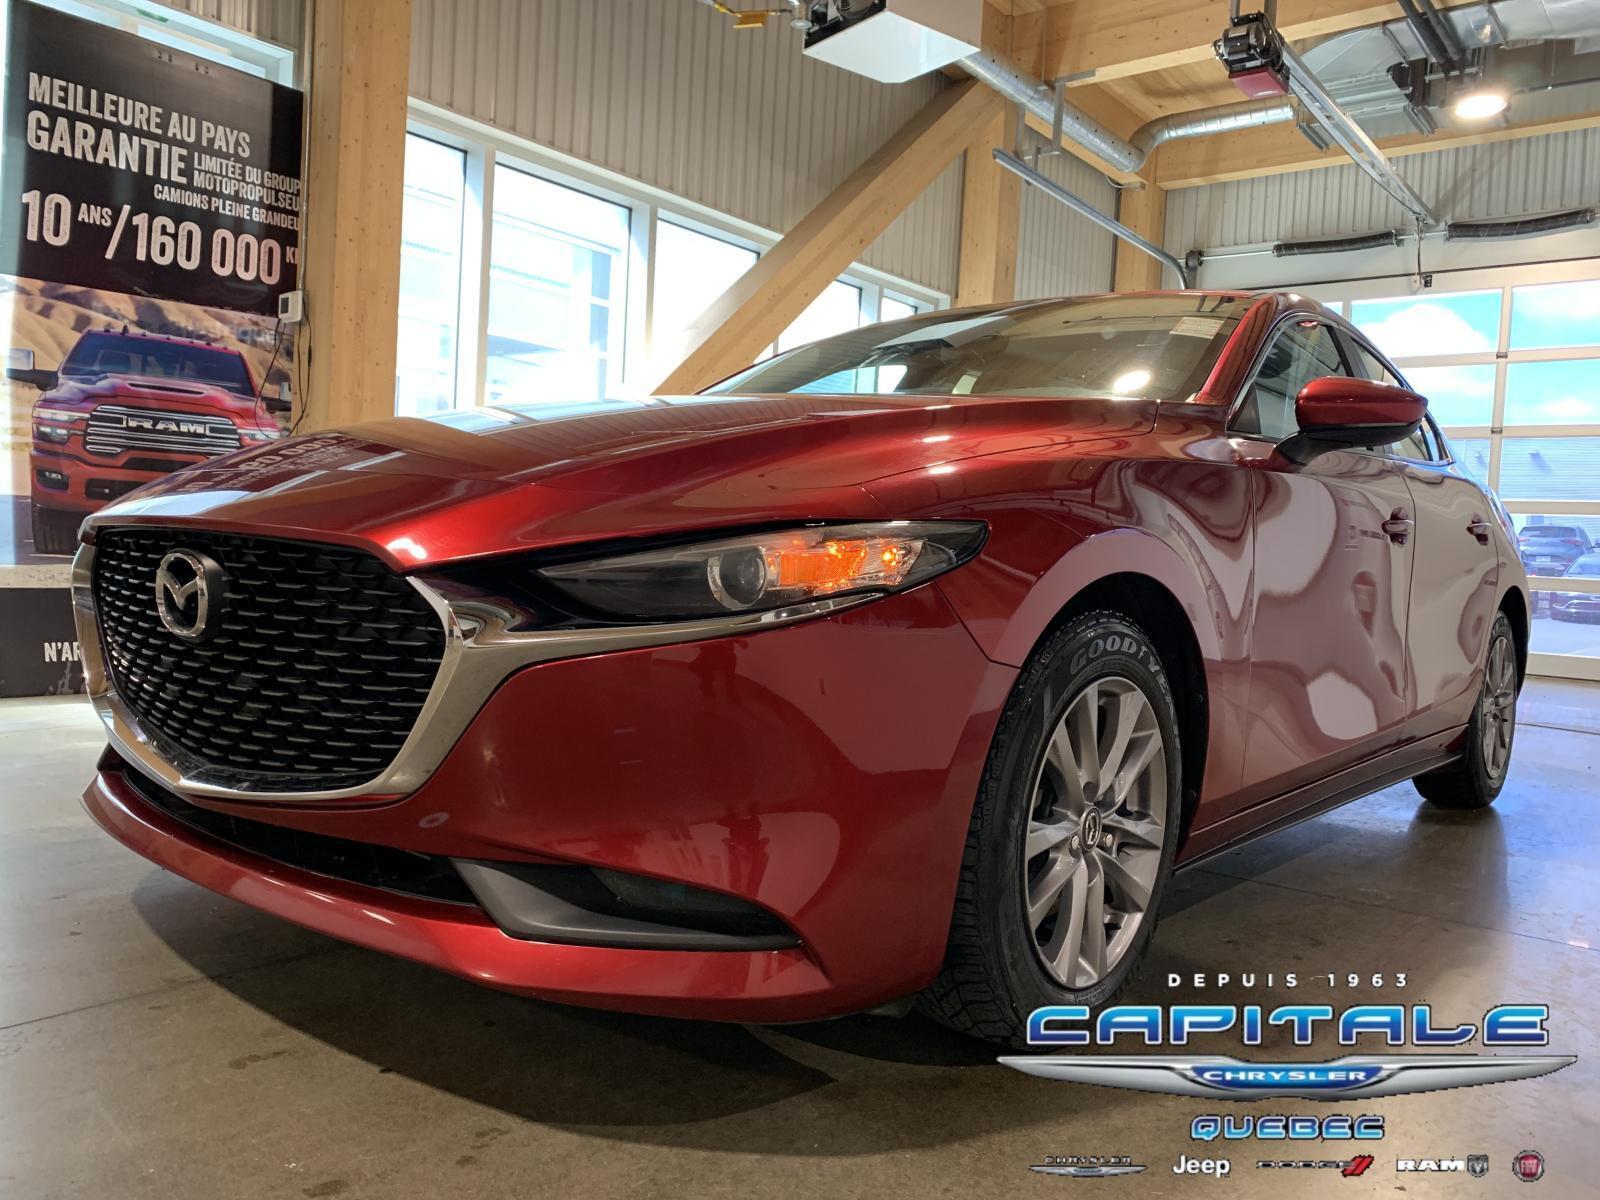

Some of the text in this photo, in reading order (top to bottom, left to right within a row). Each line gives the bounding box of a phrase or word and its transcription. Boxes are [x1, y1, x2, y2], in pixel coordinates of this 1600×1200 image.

[28, 71, 250, 158] MEILLEURE AU PAYS
[26, 109, 188, 185] GARANTIE
[193, 151, 243, 180] LIMITÉE
[245, 165, 261, 185] DU
[153, 184, 209, 210] CAMIONS
[211, 197, 251, 220] PLEINE
[21, 189, 72, 247] 10
[77, 202, 113, 227] ANS
[211, 228, 281, 285] 000
[127, 417, 205, 434] RAM
